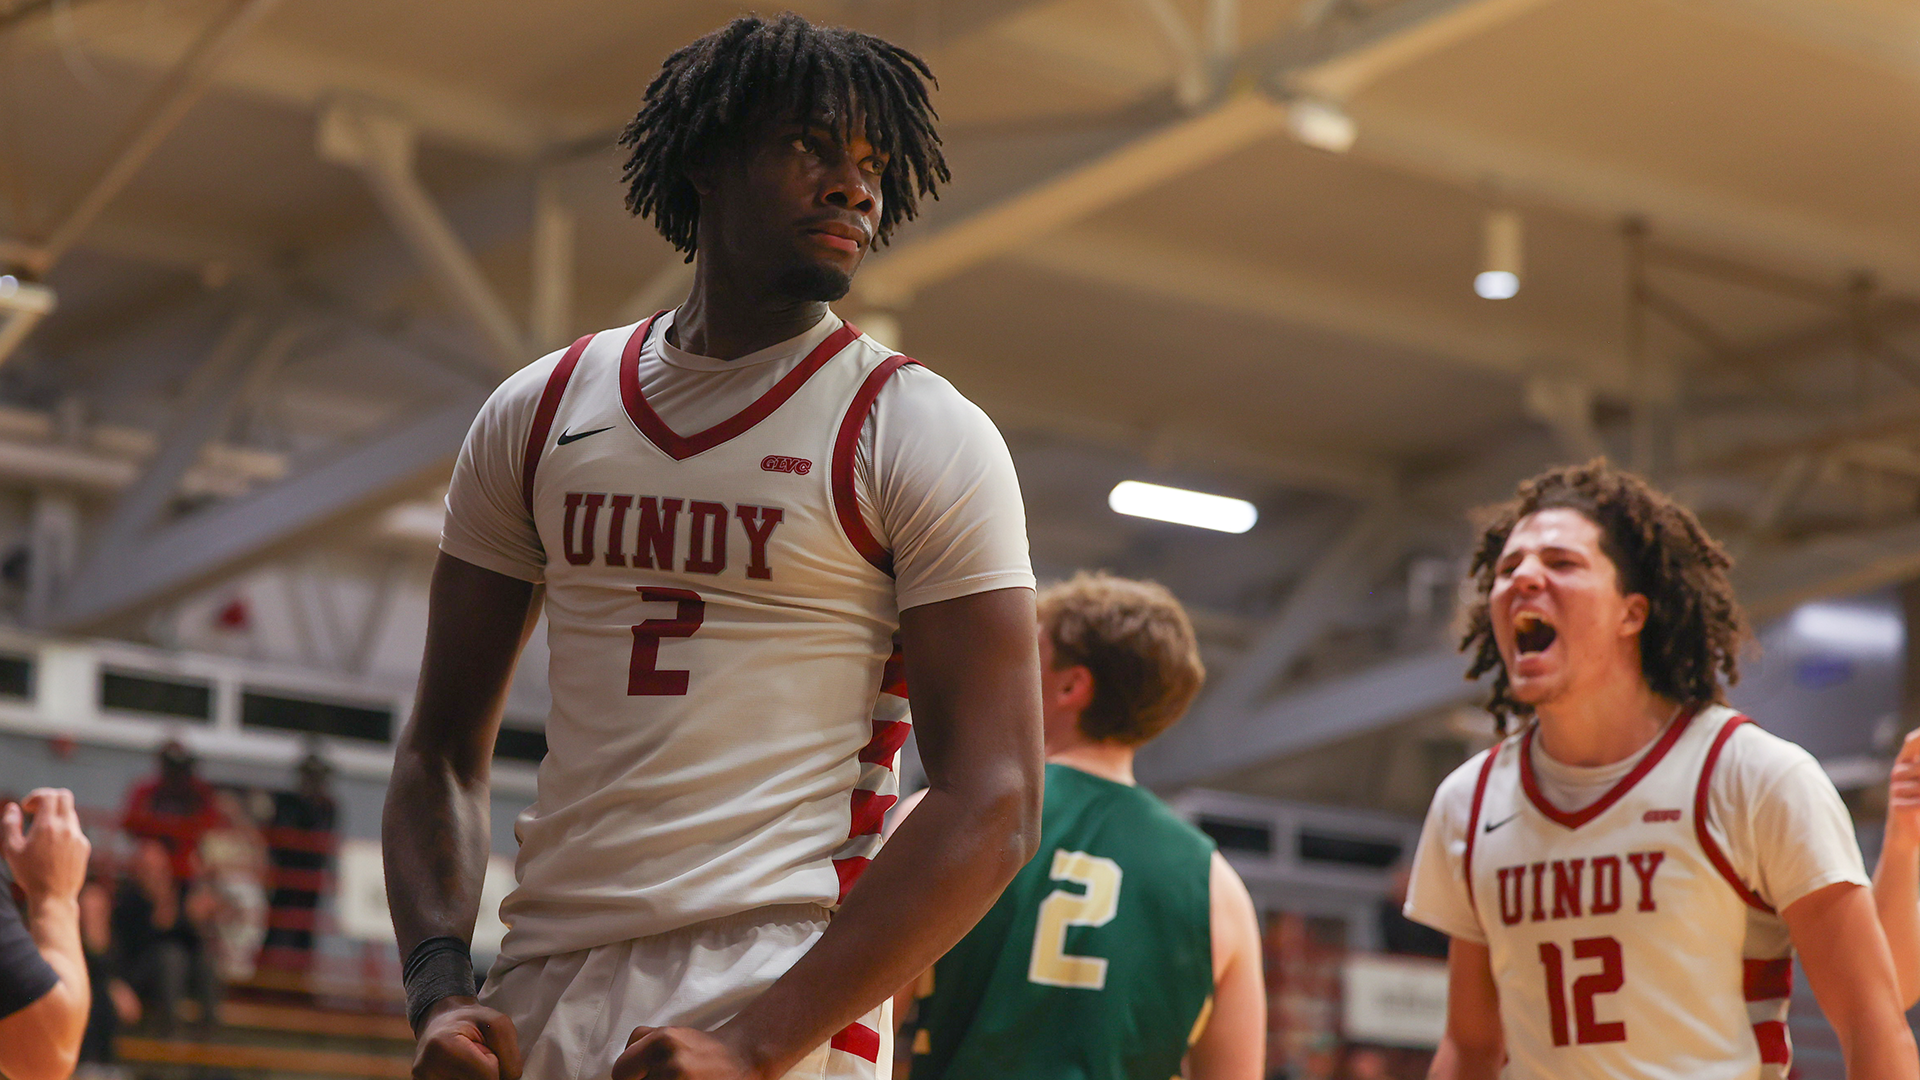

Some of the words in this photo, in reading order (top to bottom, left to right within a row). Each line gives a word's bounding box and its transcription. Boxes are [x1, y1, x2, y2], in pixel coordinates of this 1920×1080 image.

[760, 455, 812, 475] GLVC
[563, 492, 784, 580] UINDY
[627, 586, 706, 696] 2
[1028, 848, 1123, 990] 2
[1496, 851, 1665, 926] UINDY
[1538, 936, 1626, 1047] 12
